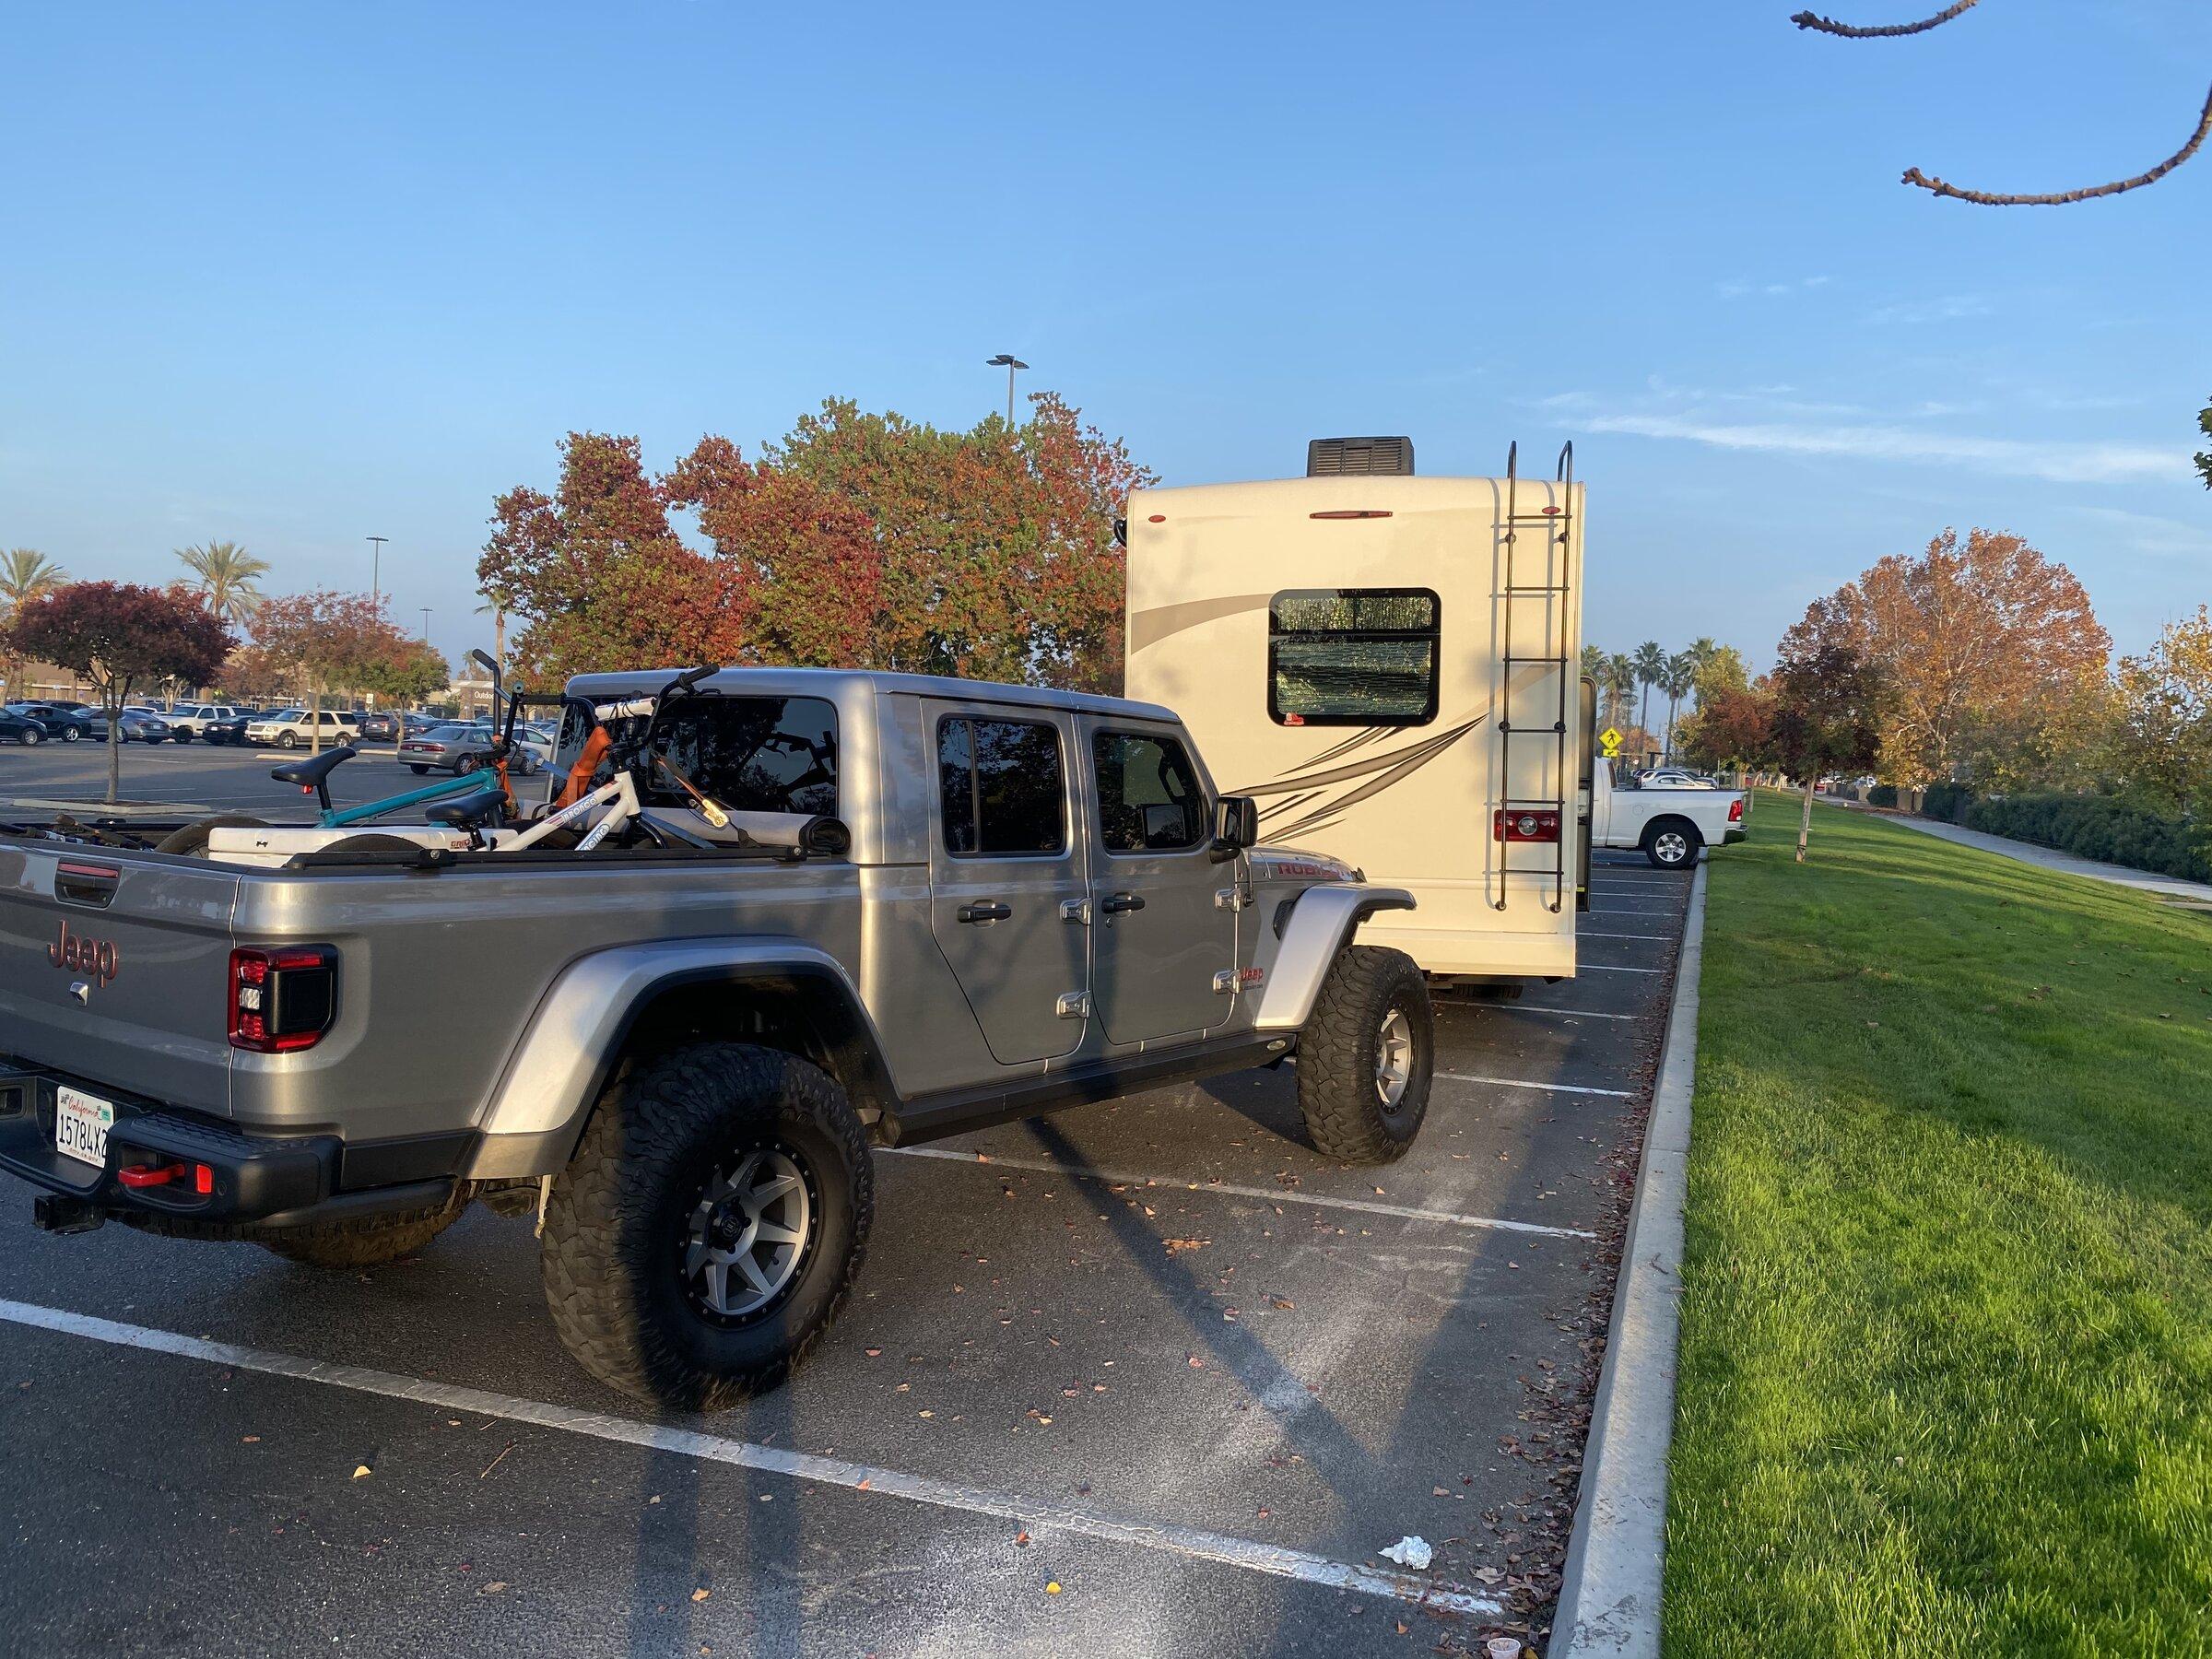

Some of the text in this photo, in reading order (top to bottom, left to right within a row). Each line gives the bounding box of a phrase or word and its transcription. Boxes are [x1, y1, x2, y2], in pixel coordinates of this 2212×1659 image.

[563, 797, 597, 821] BRONCO
[47, 919, 119, 988] Jeep
[1241, 967, 1264, 982] Jeep
[68, 1096, 100, 1118] California
